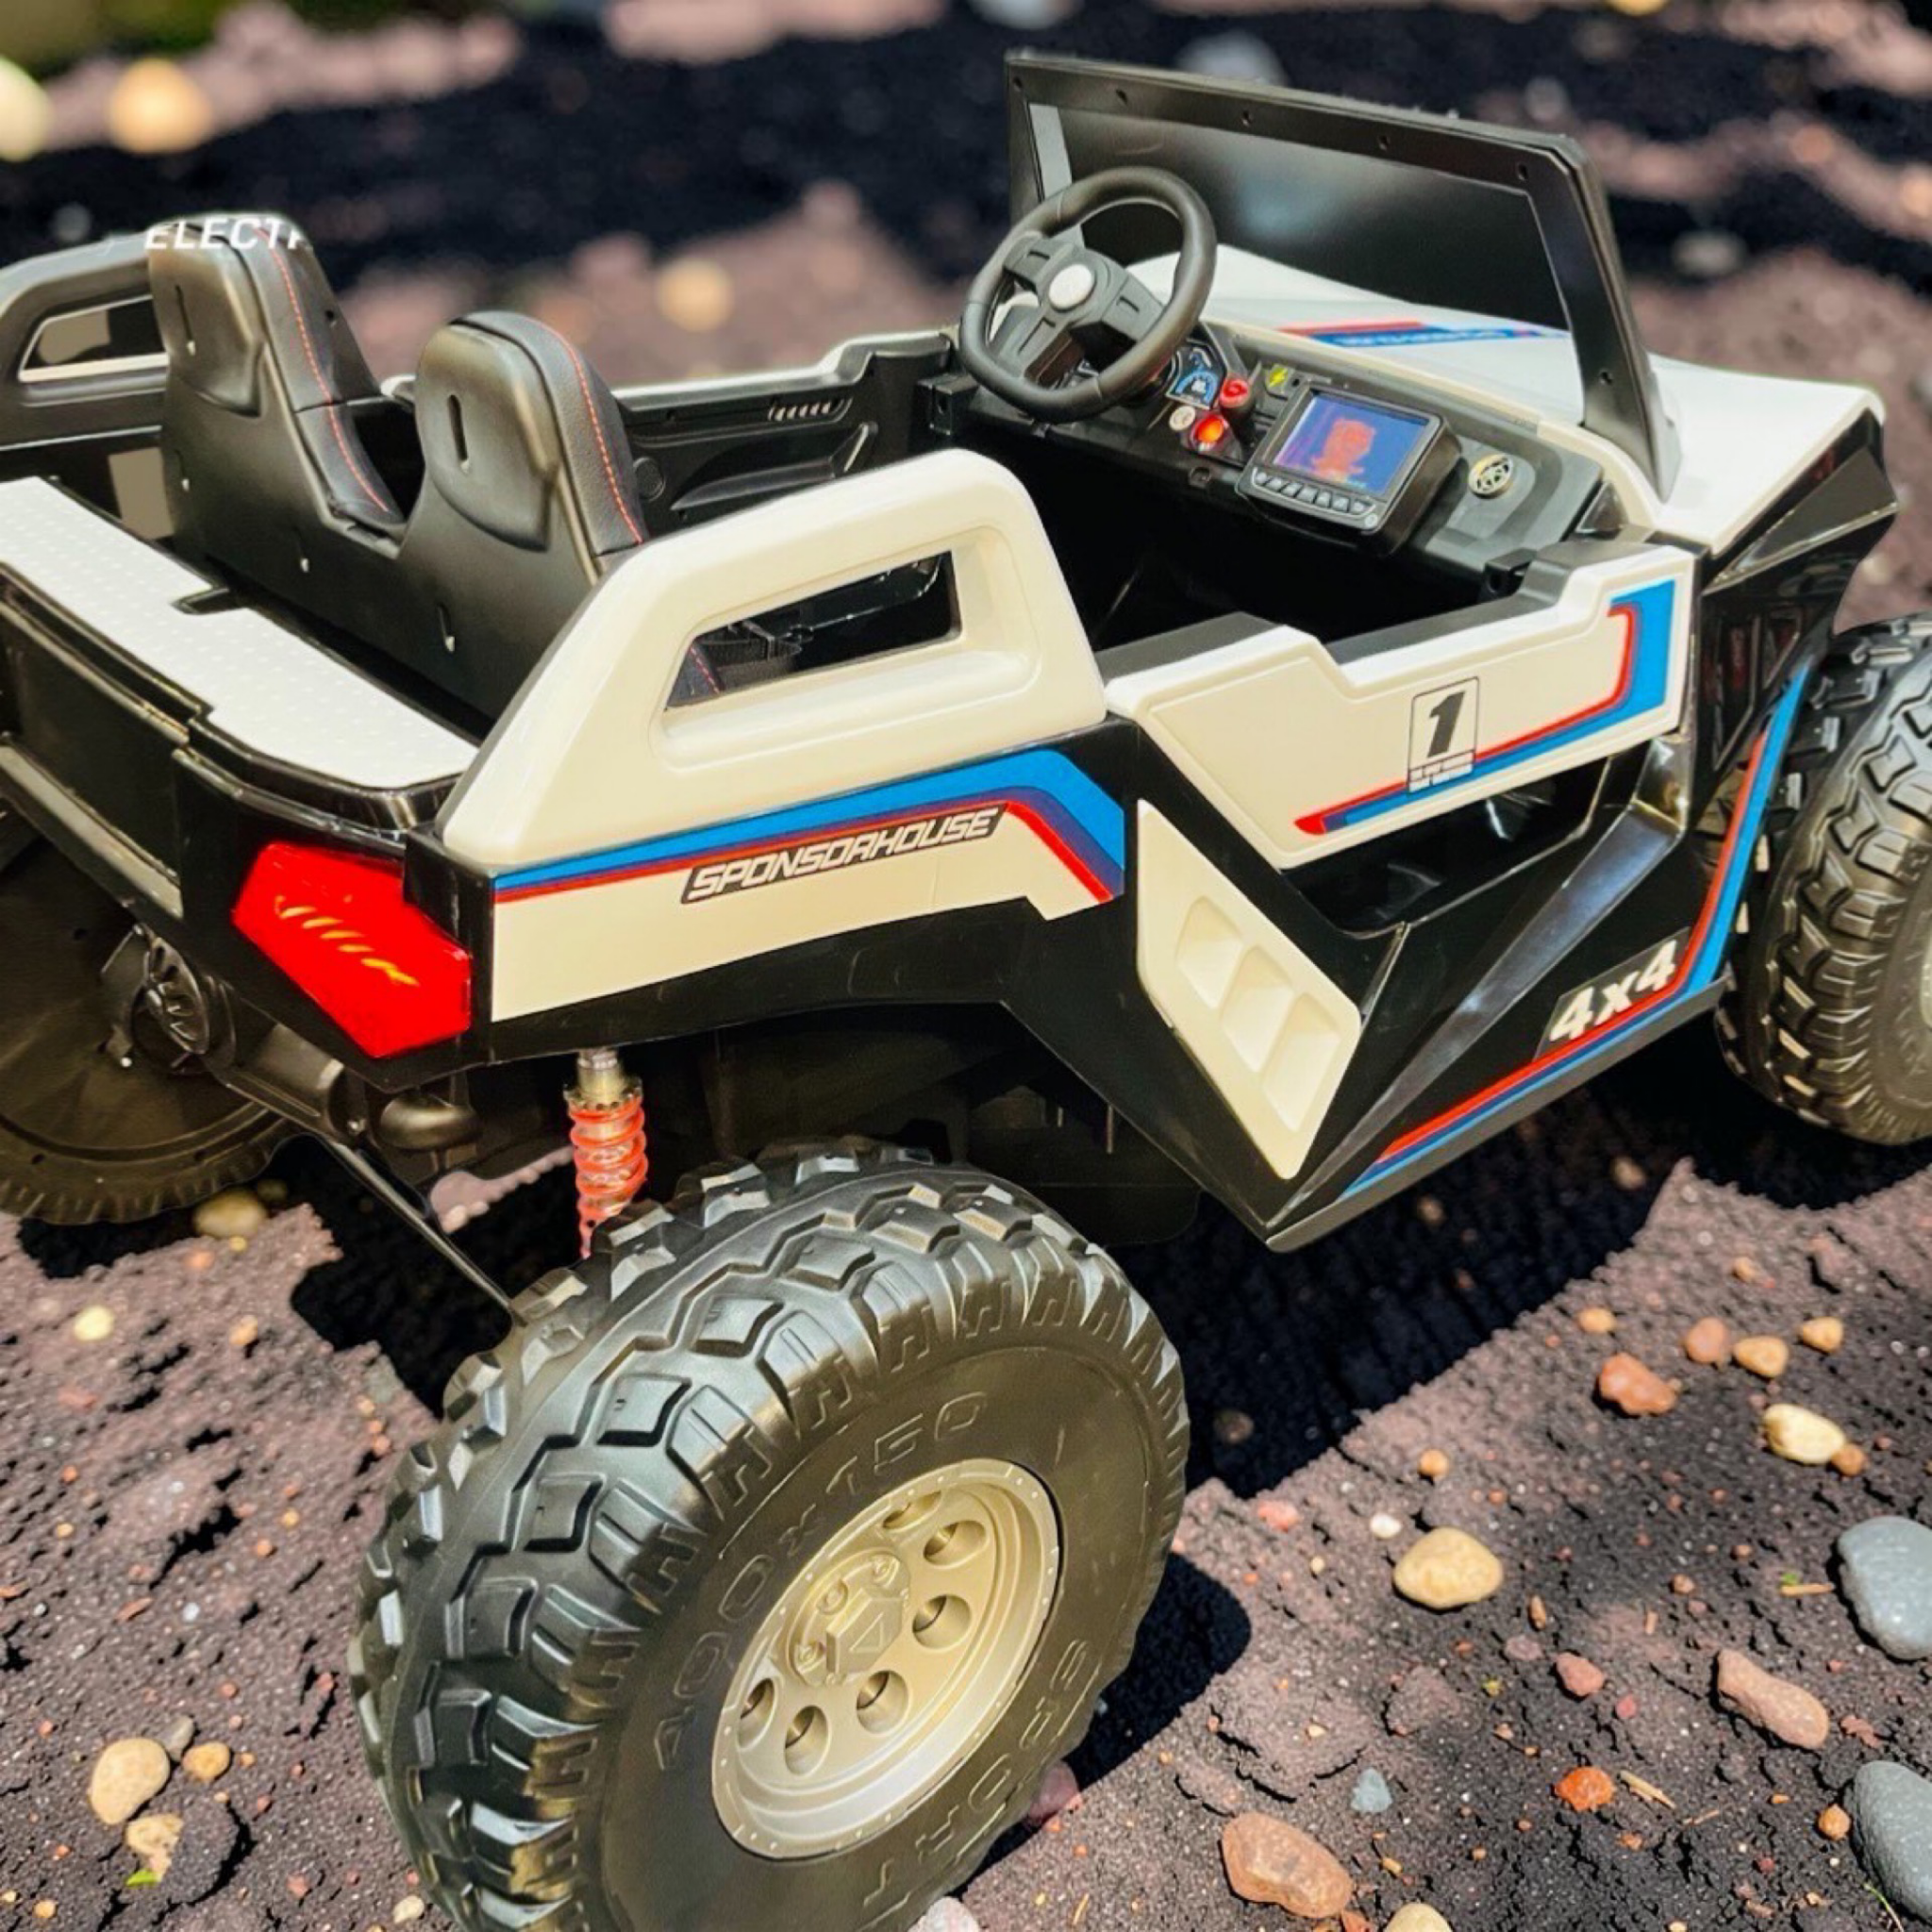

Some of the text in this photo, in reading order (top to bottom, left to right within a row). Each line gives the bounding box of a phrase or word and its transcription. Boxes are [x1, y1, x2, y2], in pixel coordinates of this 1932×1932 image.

[1427, 690, 1466, 758] 1
[687, 808, 999, 901] SPONSORHOUSE
[1549, 939, 1677, 1042] 4x4
